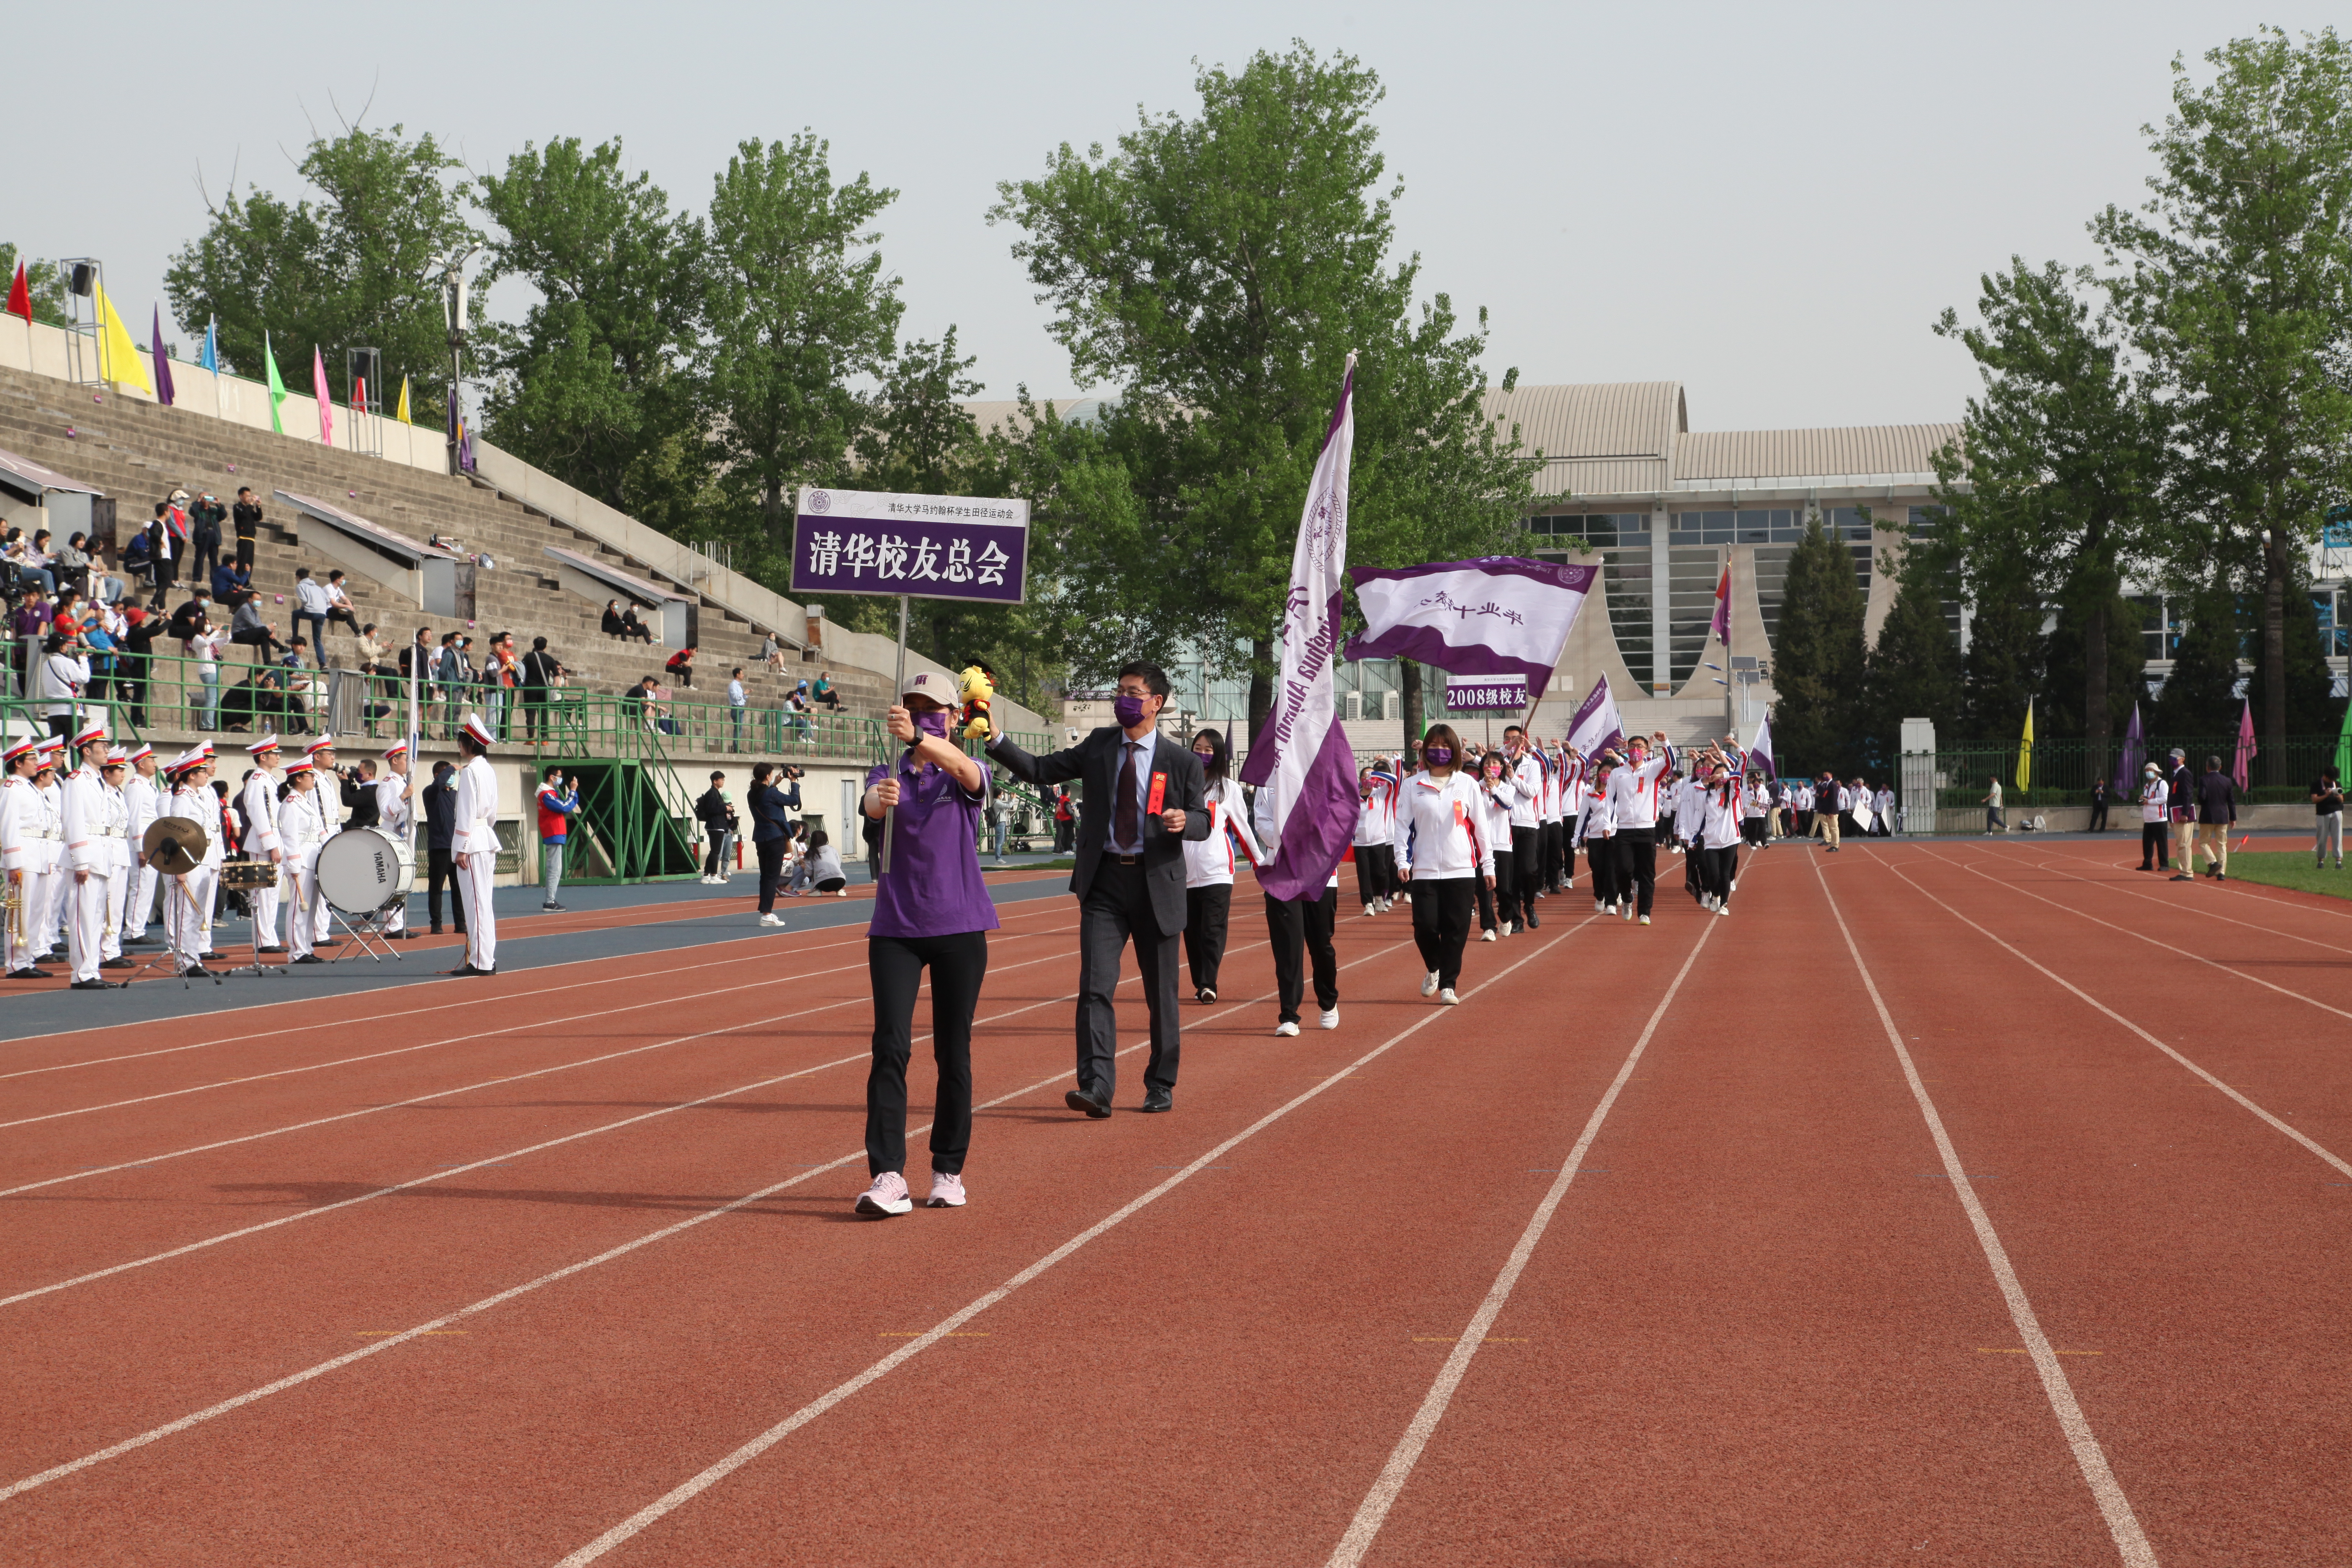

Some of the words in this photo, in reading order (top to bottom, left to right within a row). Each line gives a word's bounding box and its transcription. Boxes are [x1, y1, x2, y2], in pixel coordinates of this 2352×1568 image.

[888, 502, 1014, 519] 清华大学马约翰杯学生田径运动会
[810, 531, 1010, 586] 清华校友总会
[1447, 687, 1526, 706] 2008级校友
[374, 851, 386, 884] YAMAHA
